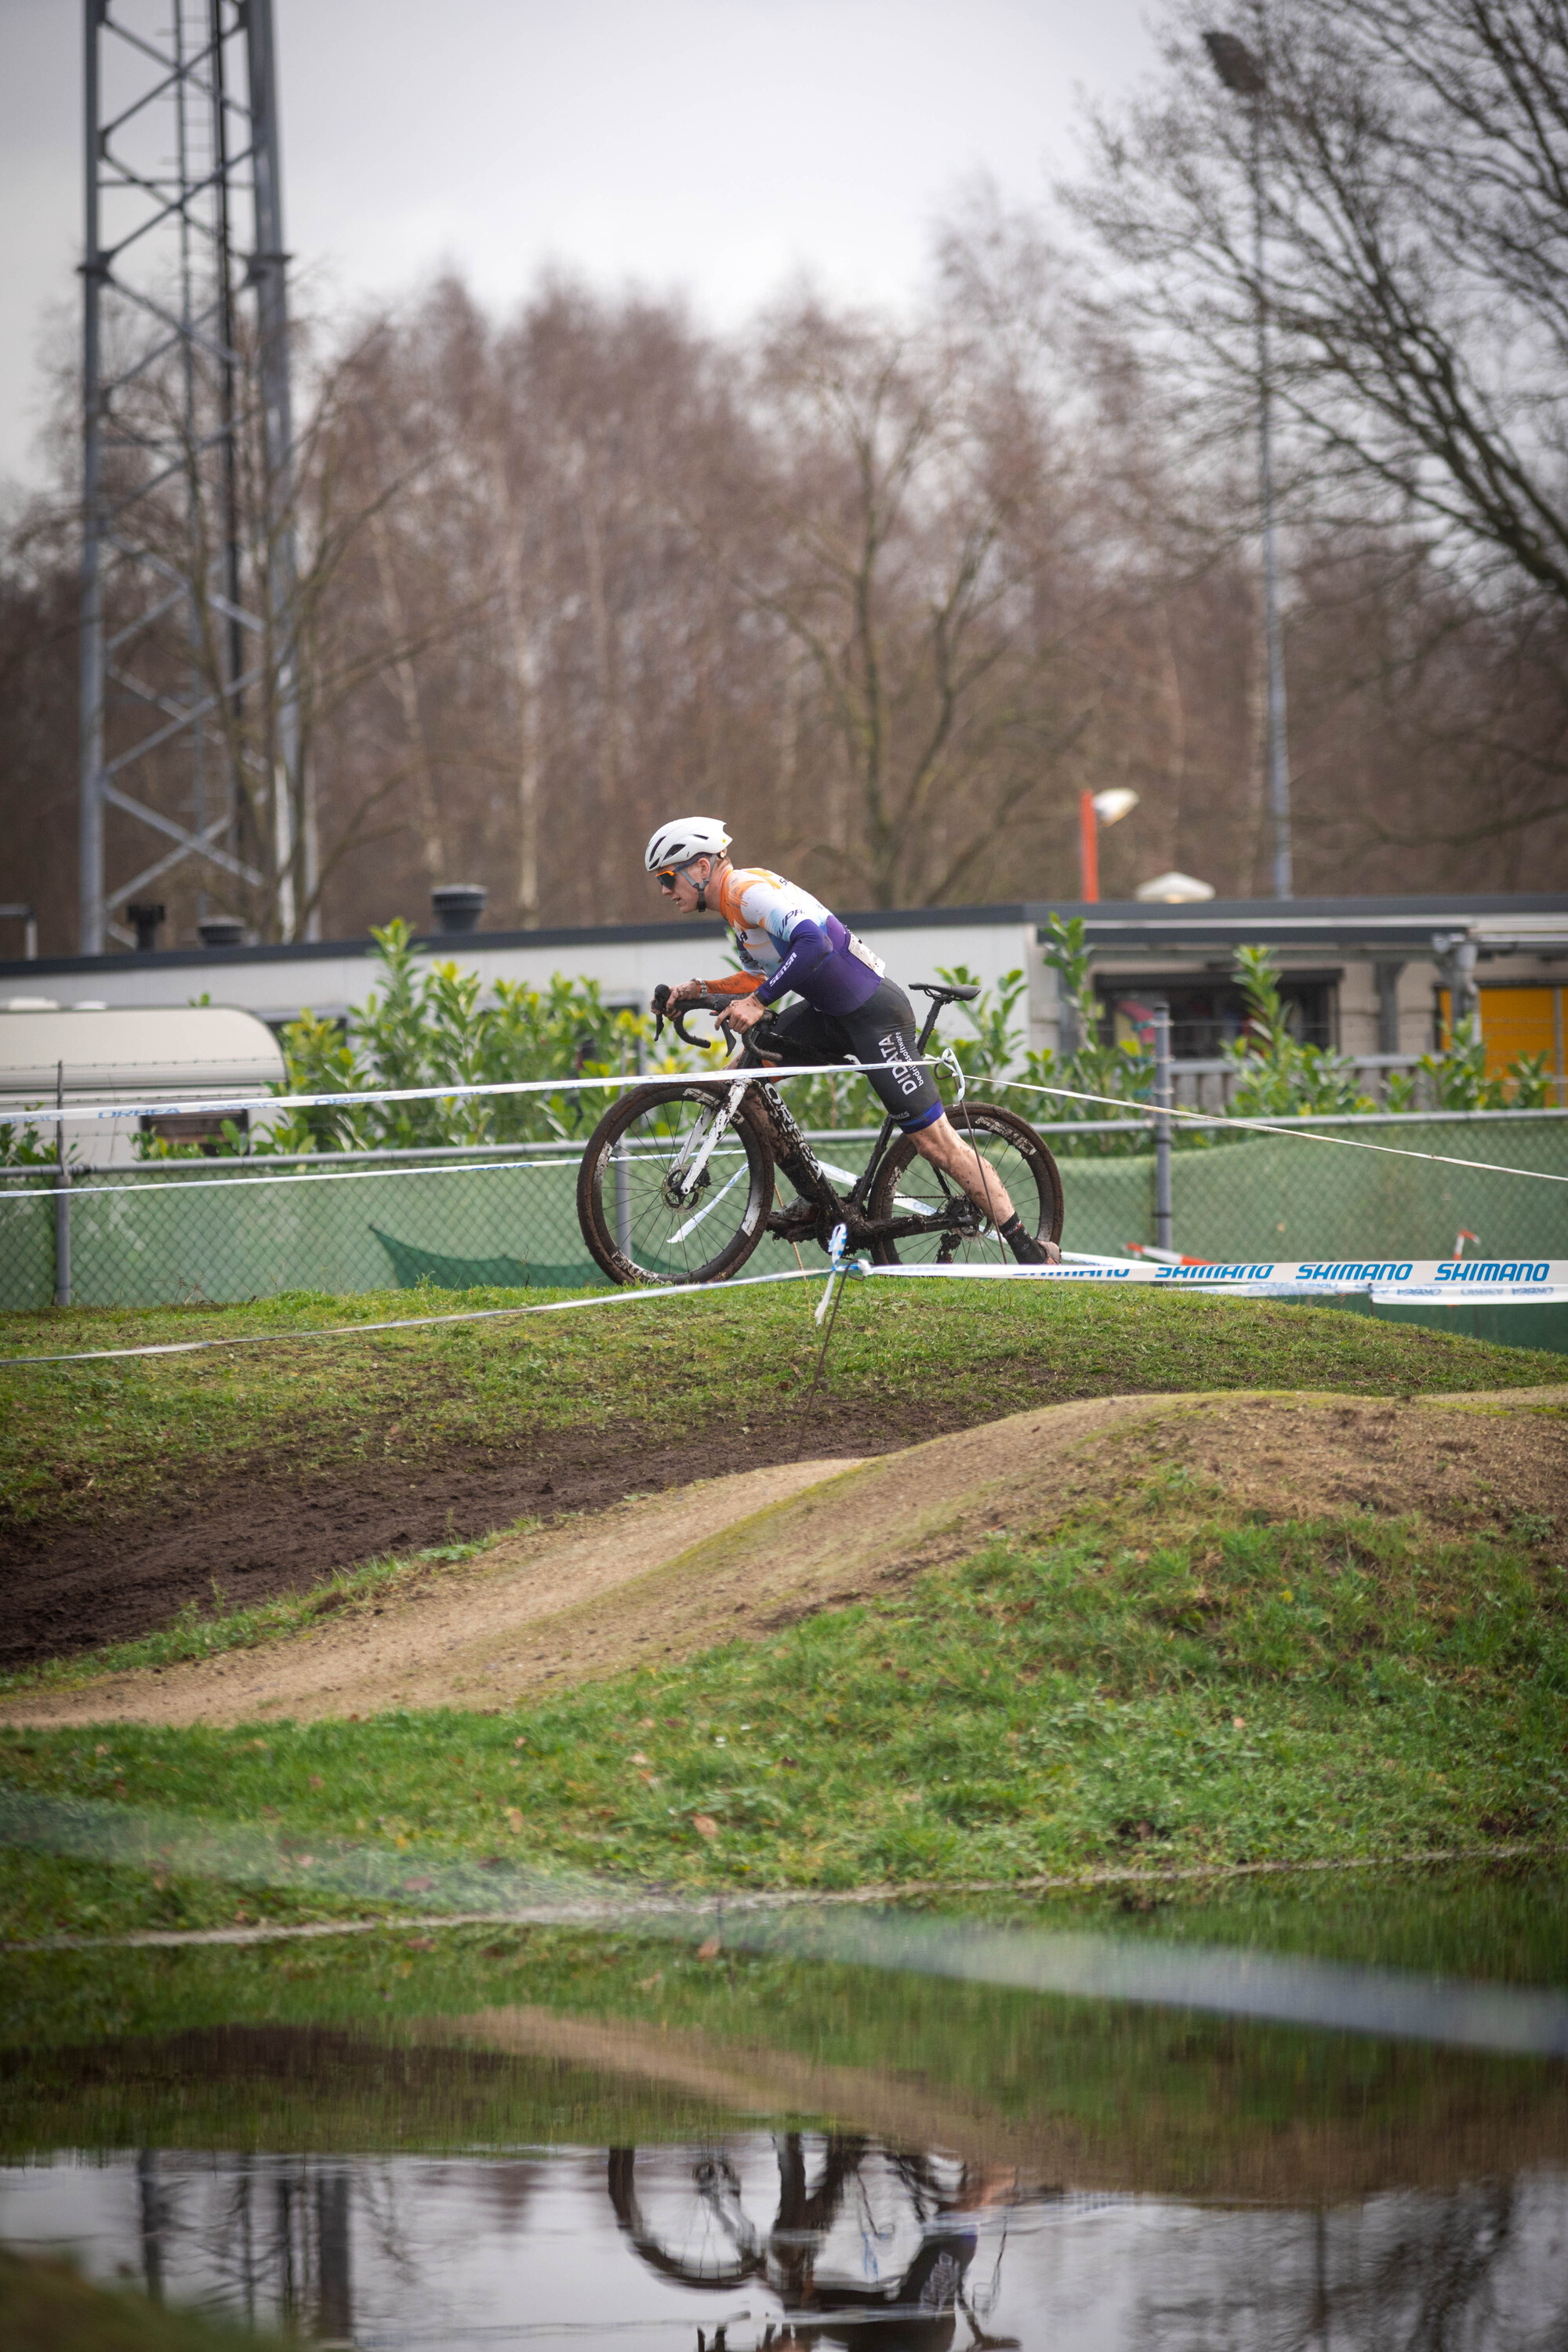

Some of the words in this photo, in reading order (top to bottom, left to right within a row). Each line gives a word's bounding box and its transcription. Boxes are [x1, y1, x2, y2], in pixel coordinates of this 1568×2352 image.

[769, 952, 797, 987] SENSA
[878, 1034, 918, 1096] DIDATA
[1155, 1265, 1275, 1279] SHIMANO
[1295, 1264, 1414, 1280] SHIMANO
[1434, 1263, 1550, 1281] SHIMANO
